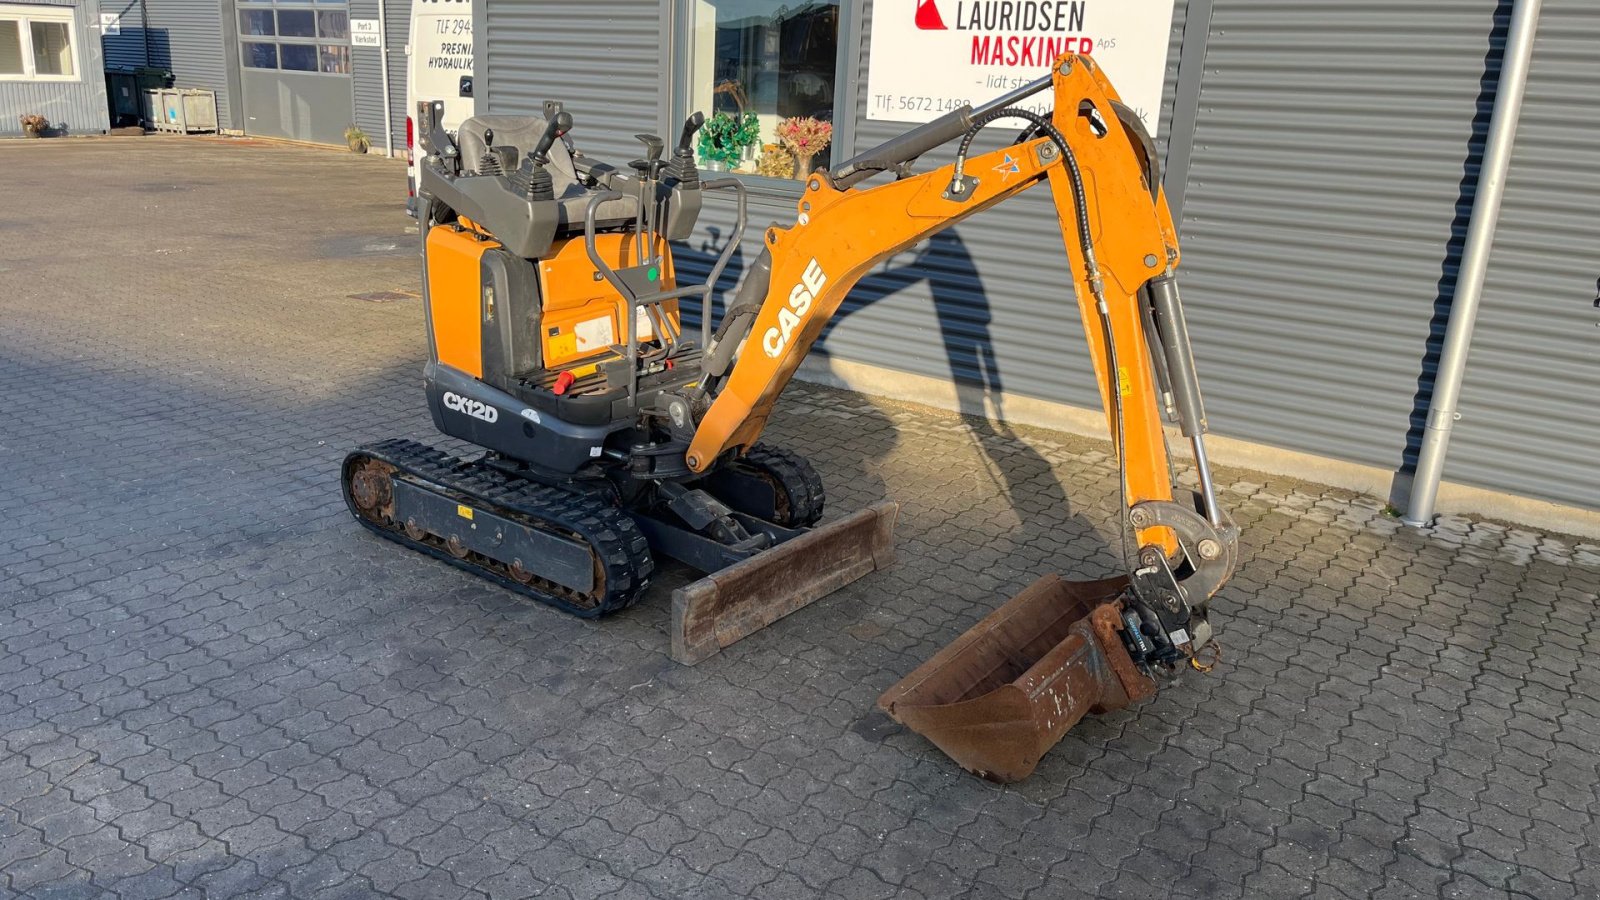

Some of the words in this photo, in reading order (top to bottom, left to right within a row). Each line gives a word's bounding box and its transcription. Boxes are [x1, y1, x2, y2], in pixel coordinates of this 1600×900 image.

[956, 1, 1085, 32] LAURIDSEN
[436, 19, 450, 34] TLF
[1097, 38, 1116, 50] ApS
[986, 74, 1008, 89] lidt
[875, 94, 894, 112] Tlf.
[899, 96, 932, 111] 5672
[763, 256, 827, 358] CASE
[443, 391, 499, 424] CX12D
